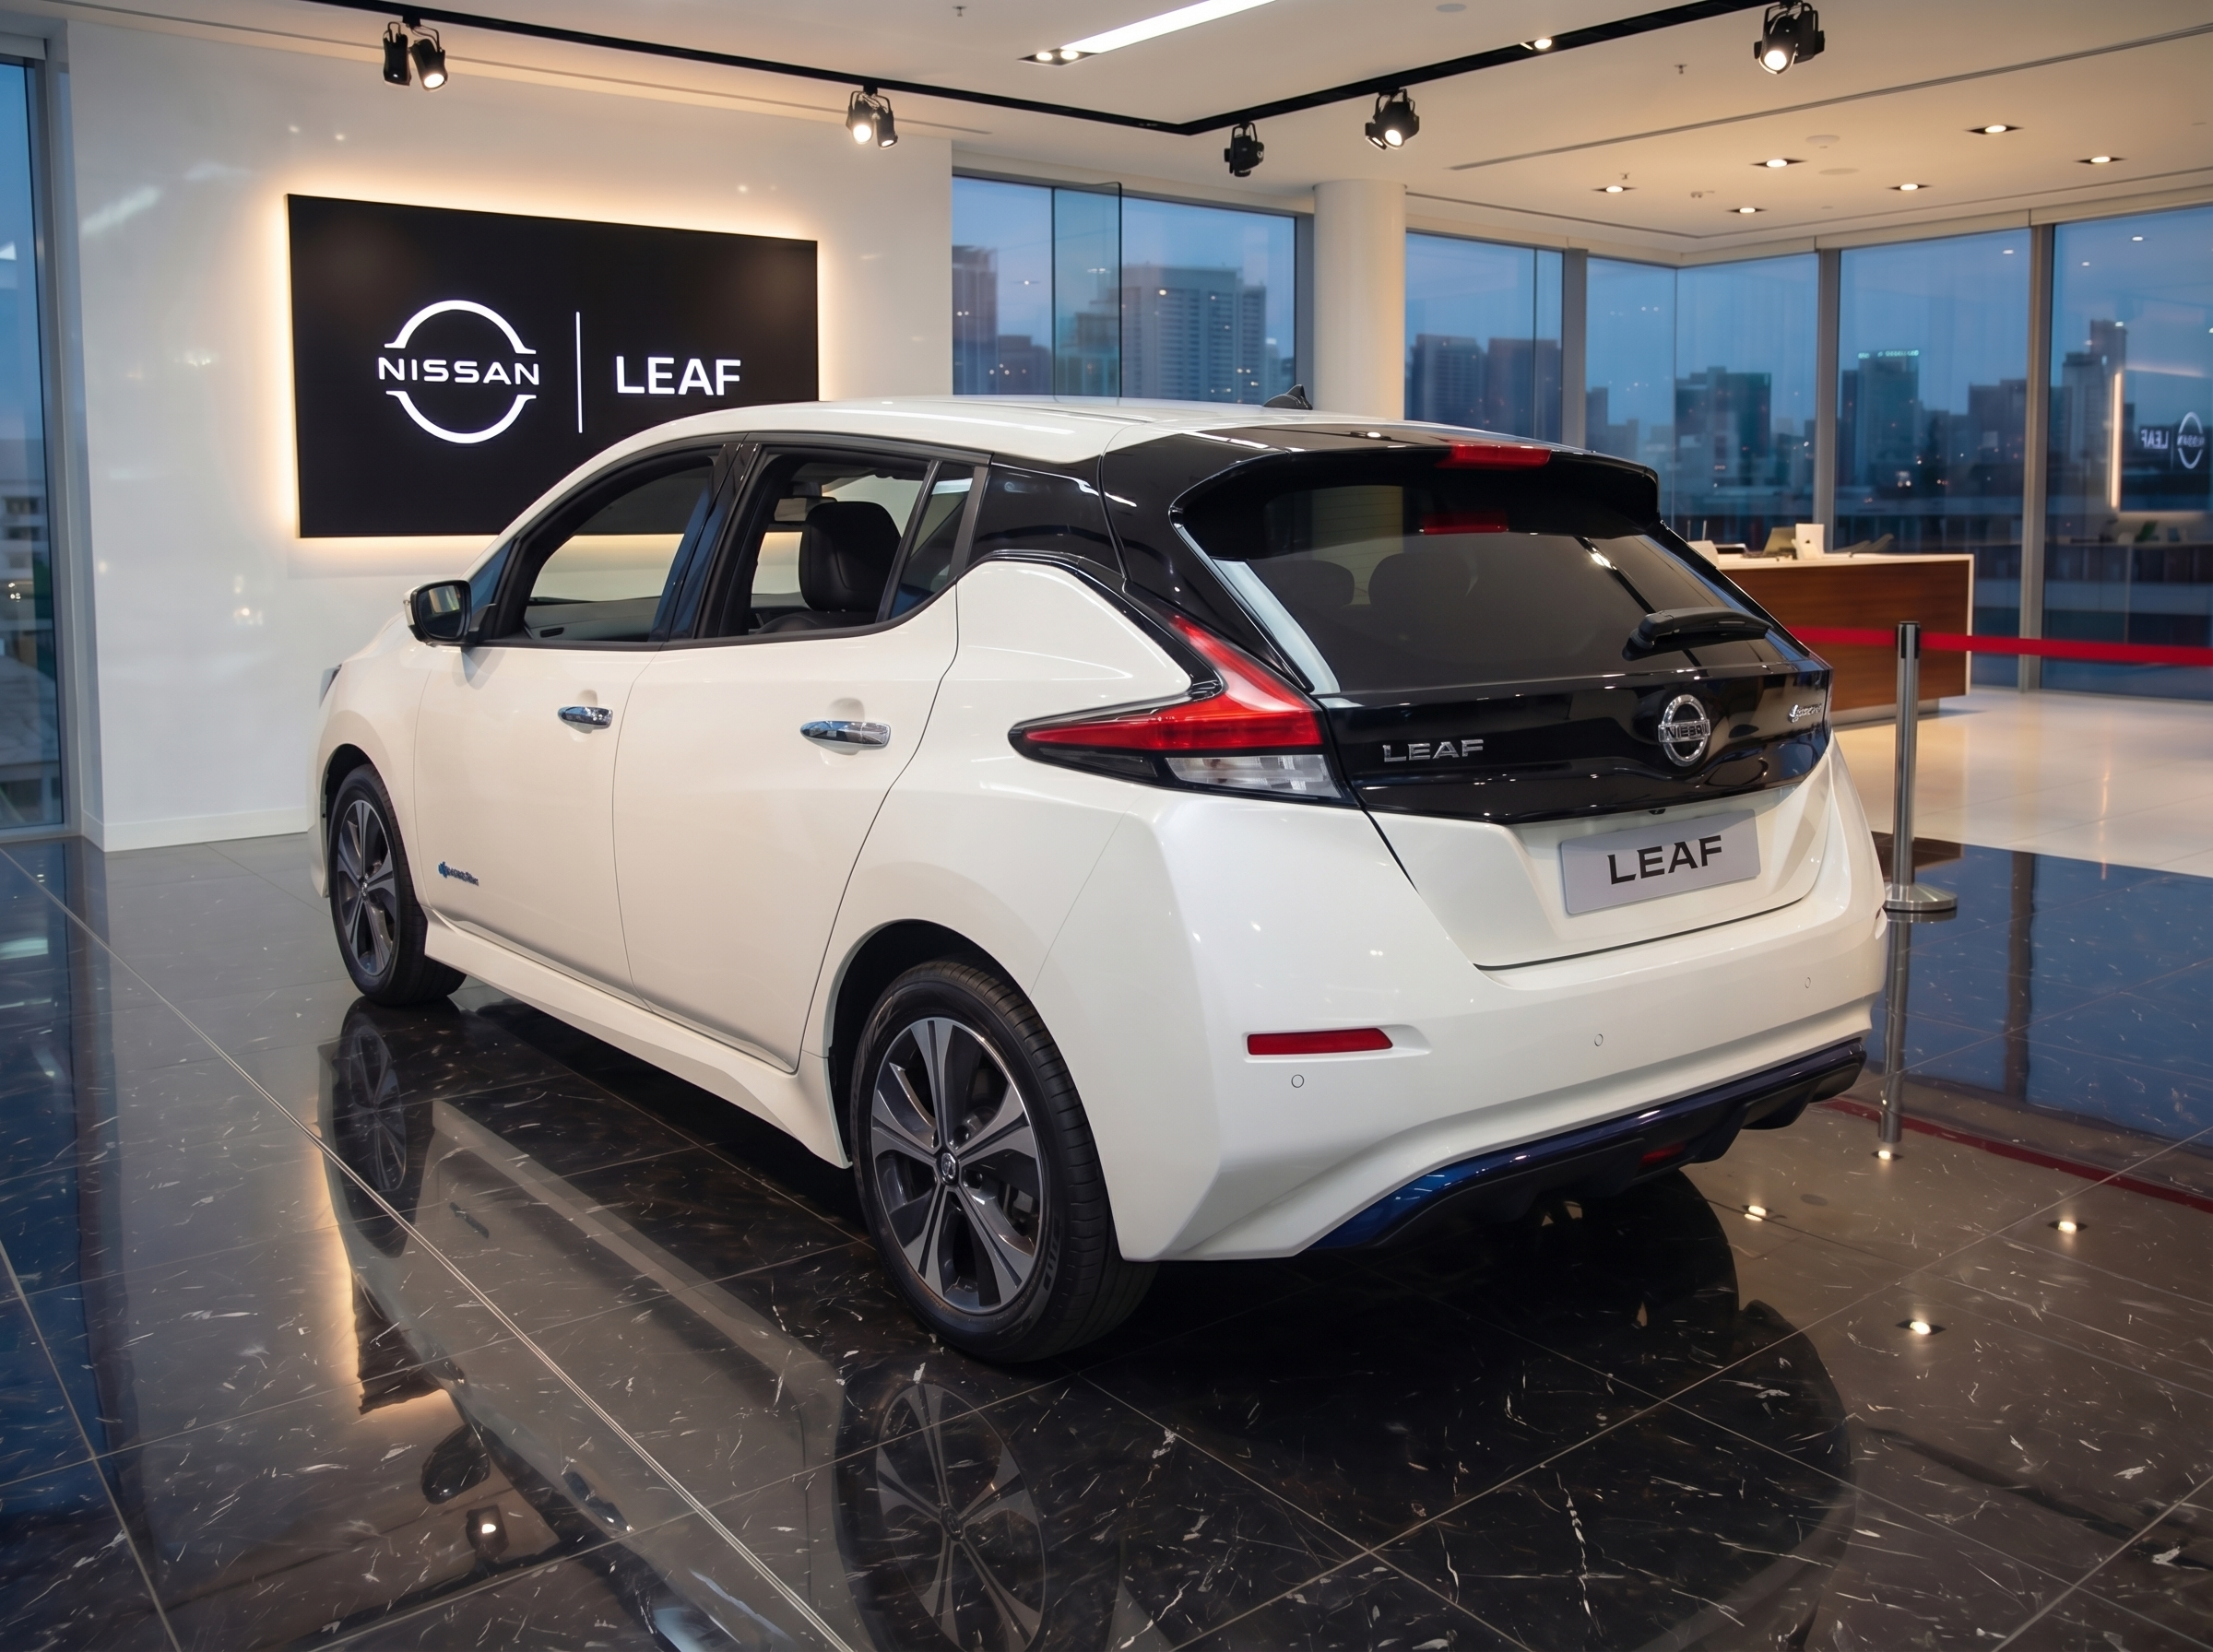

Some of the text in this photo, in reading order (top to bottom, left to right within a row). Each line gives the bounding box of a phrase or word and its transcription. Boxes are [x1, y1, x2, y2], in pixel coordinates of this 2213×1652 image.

[378, 356, 540, 385] NISSAN
[616, 355, 741, 396] LEAF
[1382, 738, 1485, 762] LEAF
[1606, 834, 1722, 885] LEAF
